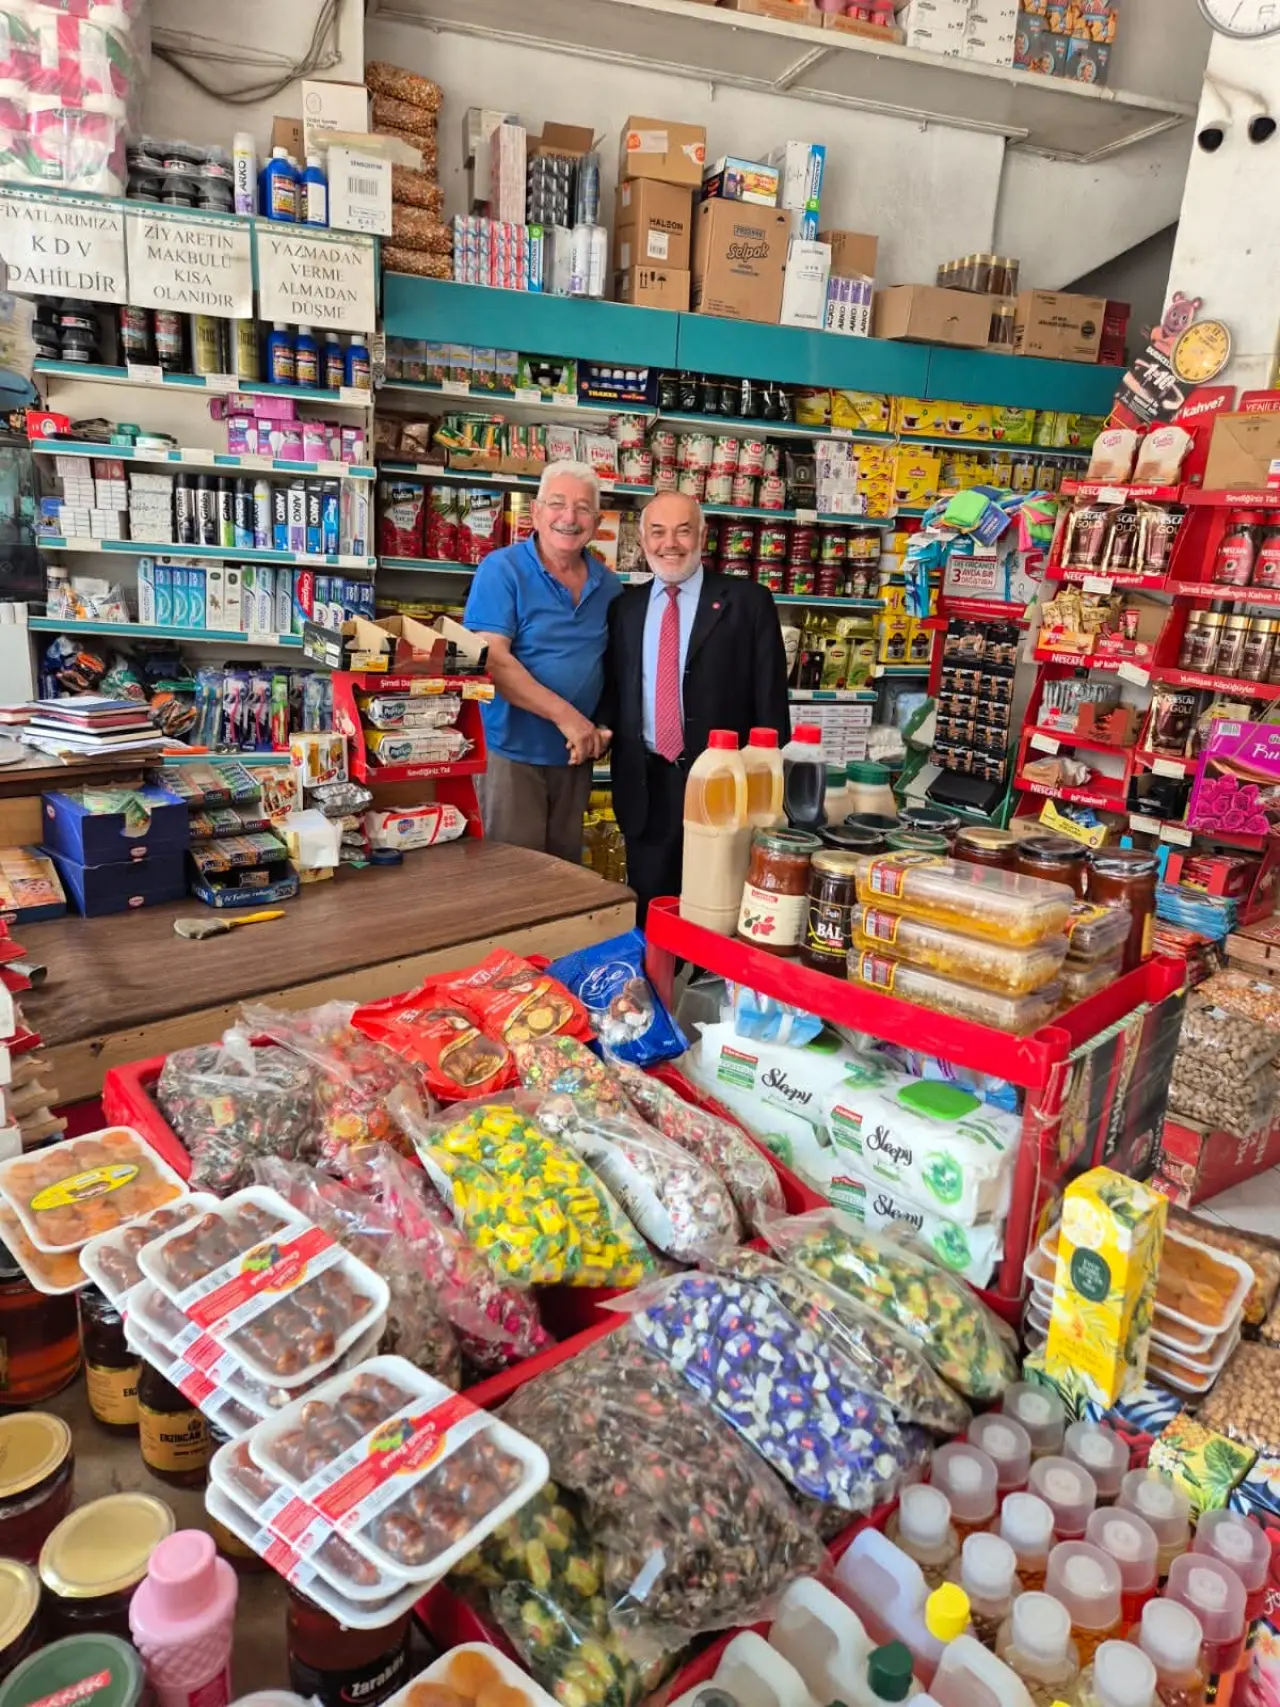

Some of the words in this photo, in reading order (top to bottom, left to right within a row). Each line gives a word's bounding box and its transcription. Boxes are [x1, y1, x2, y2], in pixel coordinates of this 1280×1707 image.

[238, 160, 247, 192] ARKO
[144, 223, 234, 249] ZİYARETİN
[147, 245, 232, 268] MAKBULÜ
[271, 240, 362, 265] YAZMADAN
[726, 242, 770, 262] Selpak
[174, 268, 212, 286] KISA
[290, 263, 345, 282] VERME
[153, 285, 234, 308] OLANIDIR
[278, 281, 358, 302] ALMADAN
[292, 300, 346, 320] DÜŞME
[276, 494, 285, 522] ARKO
[293, 495, 301, 522] ARKO
[310, 496, 319, 524] ARKO
[952, 568, 961, 583] 3
[302, 572, 310, 612] Colgate
[816, 922, 844, 941] BAL
[761, 1068, 813, 1105] Sleepy
[866, 1126, 914, 1166] Sleepy
